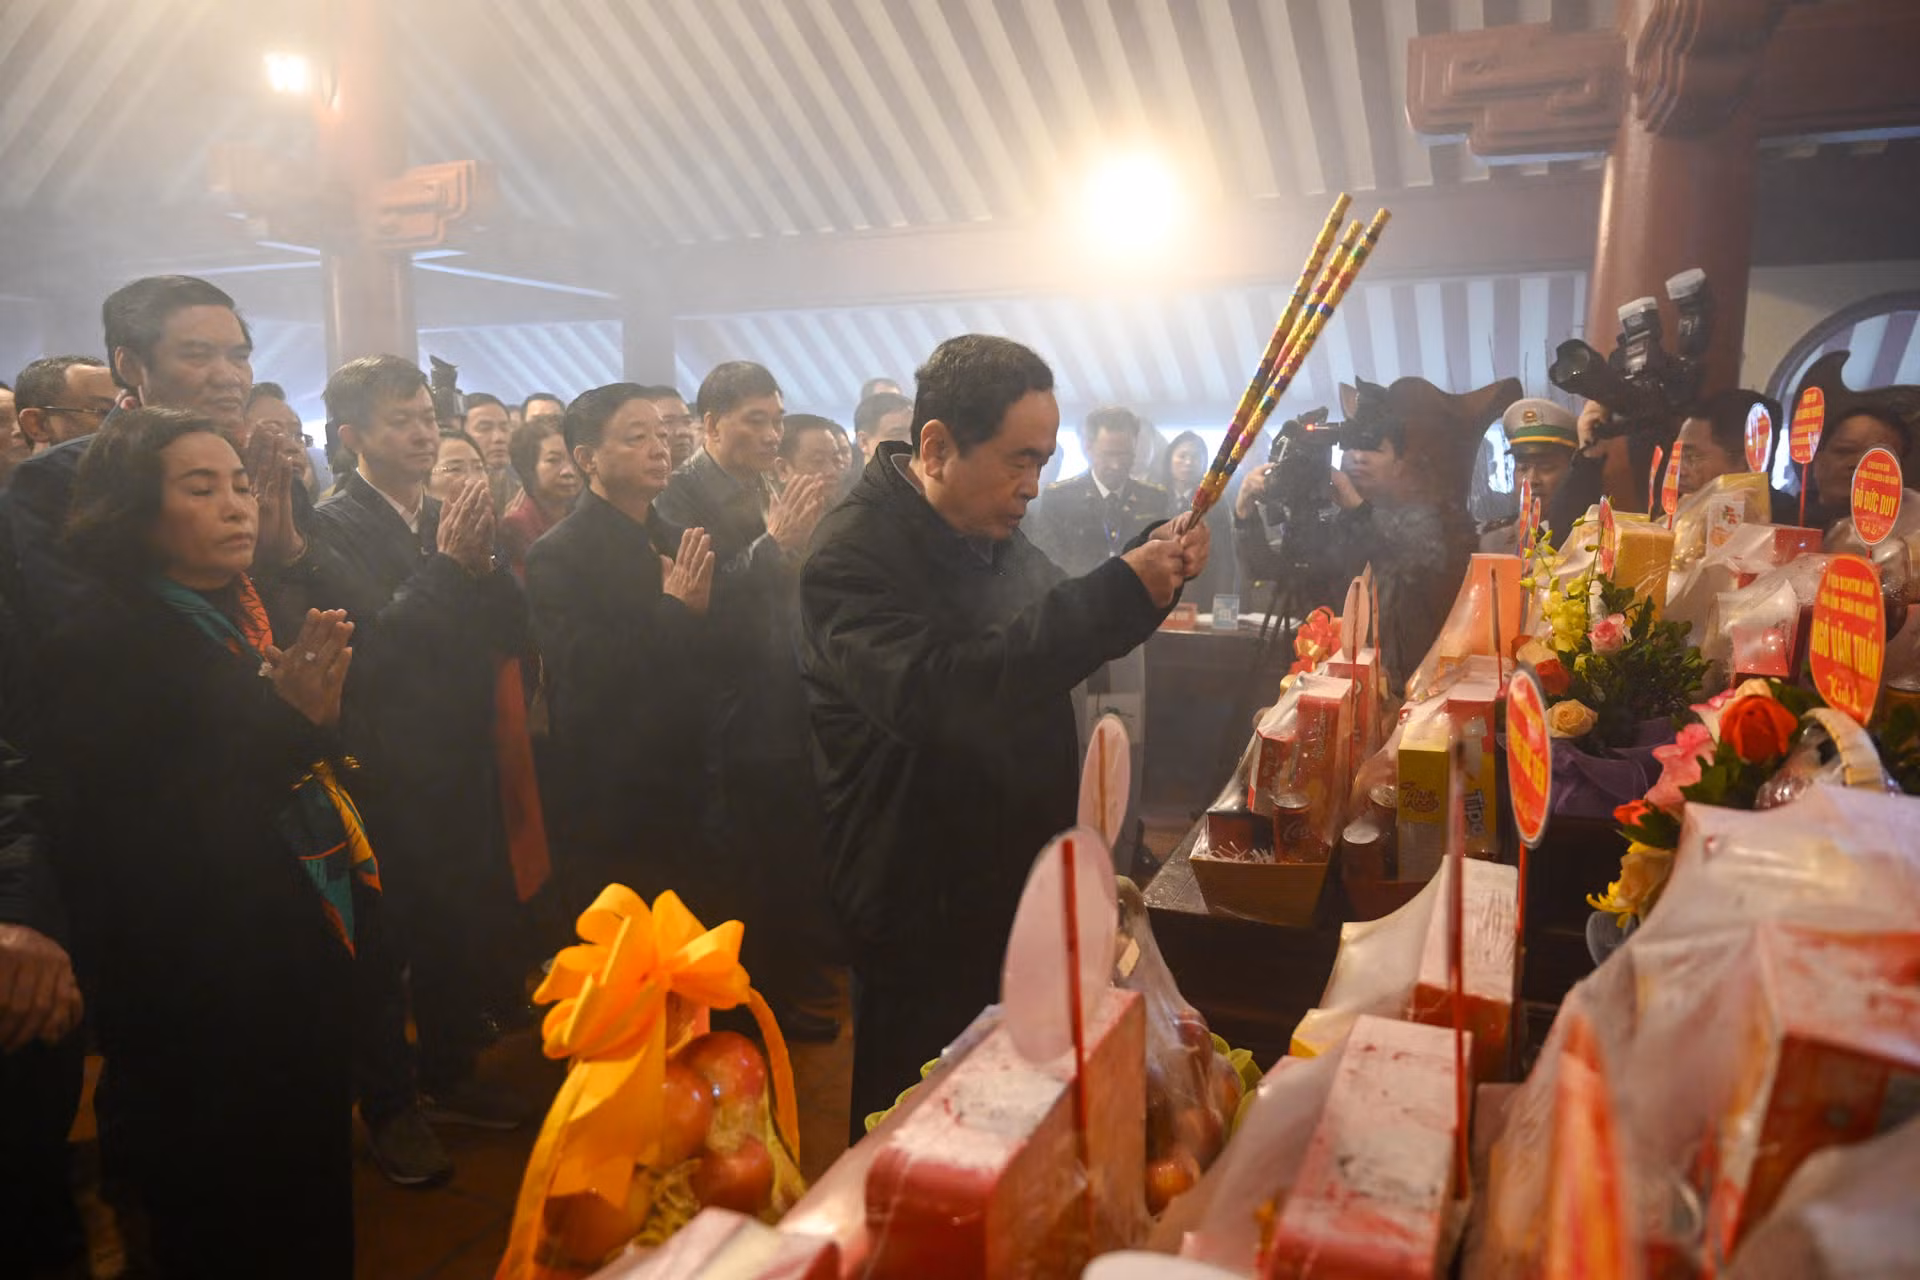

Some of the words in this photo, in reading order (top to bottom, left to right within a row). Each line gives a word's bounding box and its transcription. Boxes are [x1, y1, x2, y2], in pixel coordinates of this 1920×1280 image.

[1880, 495, 1897, 518] DUY
[1811, 616, 1830, 658] NGÔ
[1831, 621, 1852, 667] VĂN
[1853, 627, 1880, 682] TUẤN
